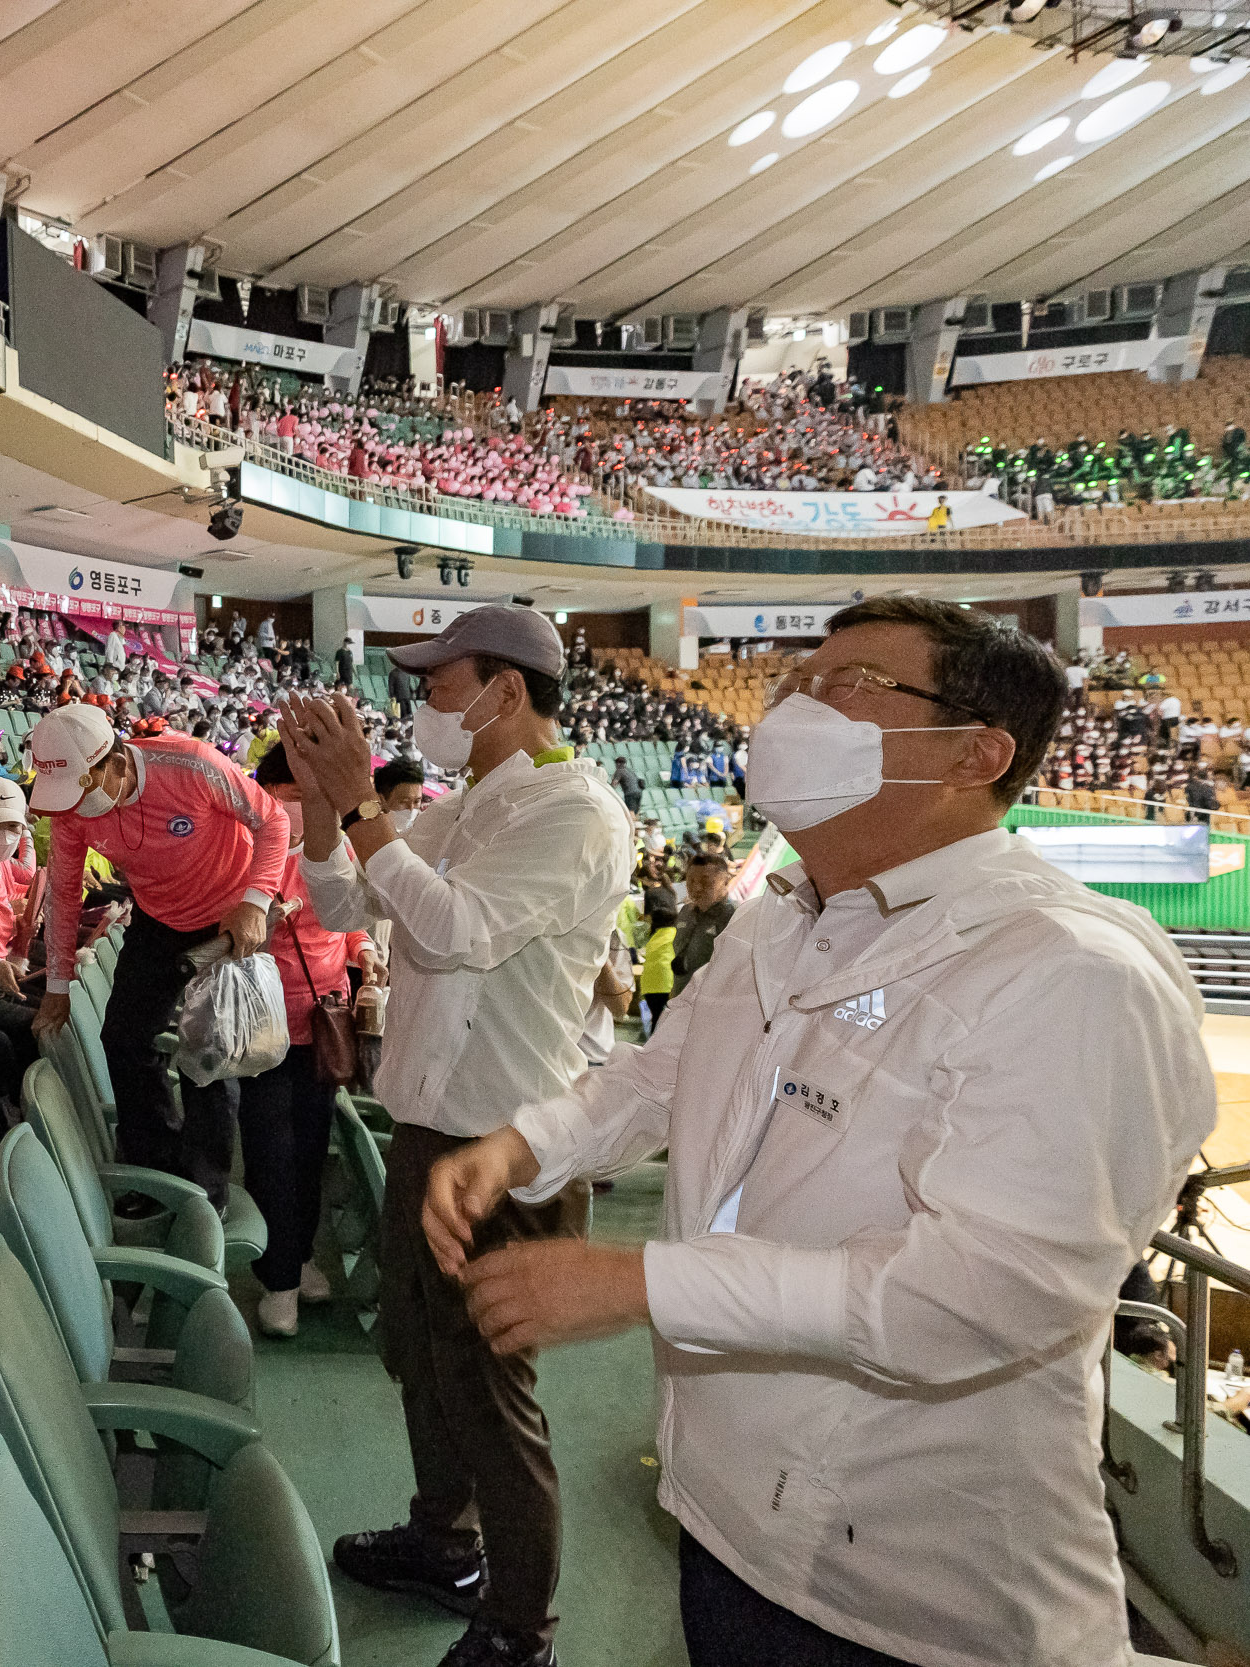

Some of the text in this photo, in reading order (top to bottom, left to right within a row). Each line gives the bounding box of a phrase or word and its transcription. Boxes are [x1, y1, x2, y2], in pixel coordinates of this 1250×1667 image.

[273, 344, 306, 362] 마포구
[1061, 352, 1110, 369] 구로구
[90, 570, 142, 596] 영등포구
[775, 615, 815, 630] 동작구
